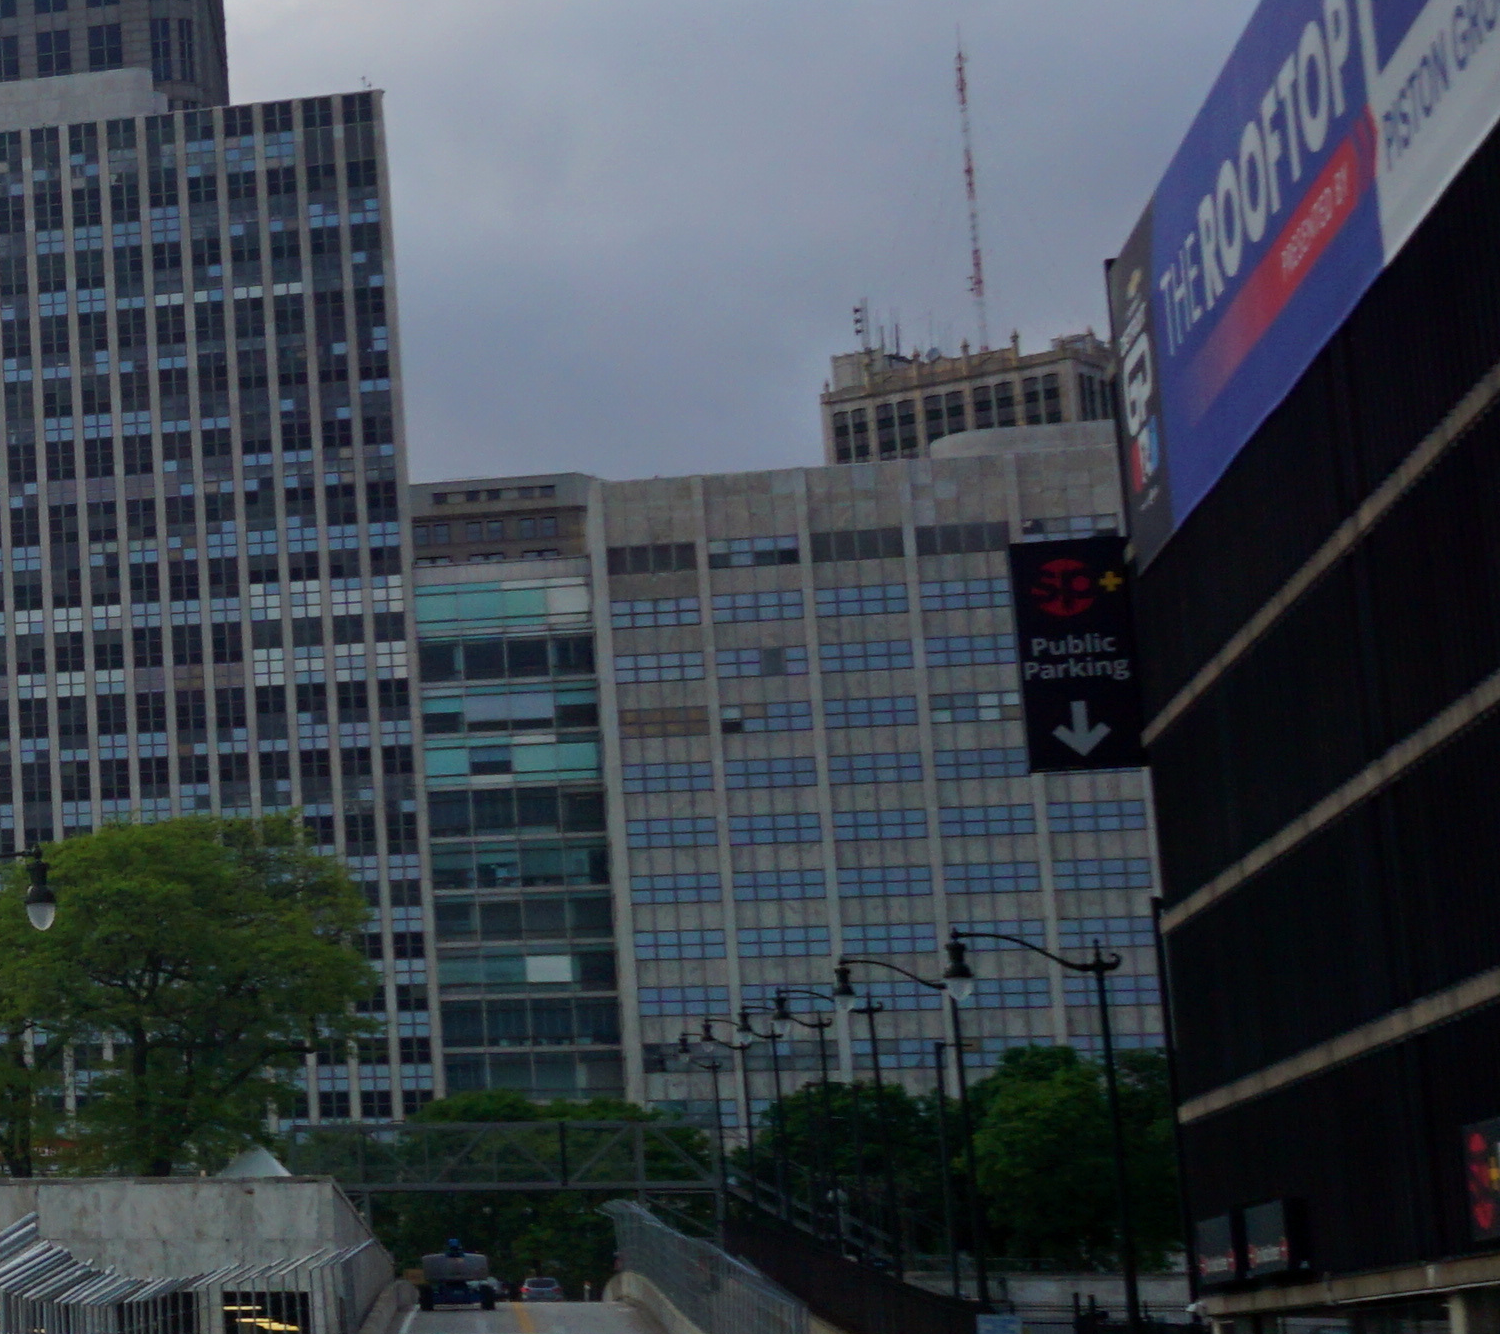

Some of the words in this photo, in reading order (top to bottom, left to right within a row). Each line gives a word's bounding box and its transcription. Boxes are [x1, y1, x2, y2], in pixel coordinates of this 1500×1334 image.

[1382, 29, 1449, 172] PISTON
[1159, 230, 1203, 357] THE
[1024, 658, 1131, 681] Parking
[1031, 633, 1116, 657] Public
